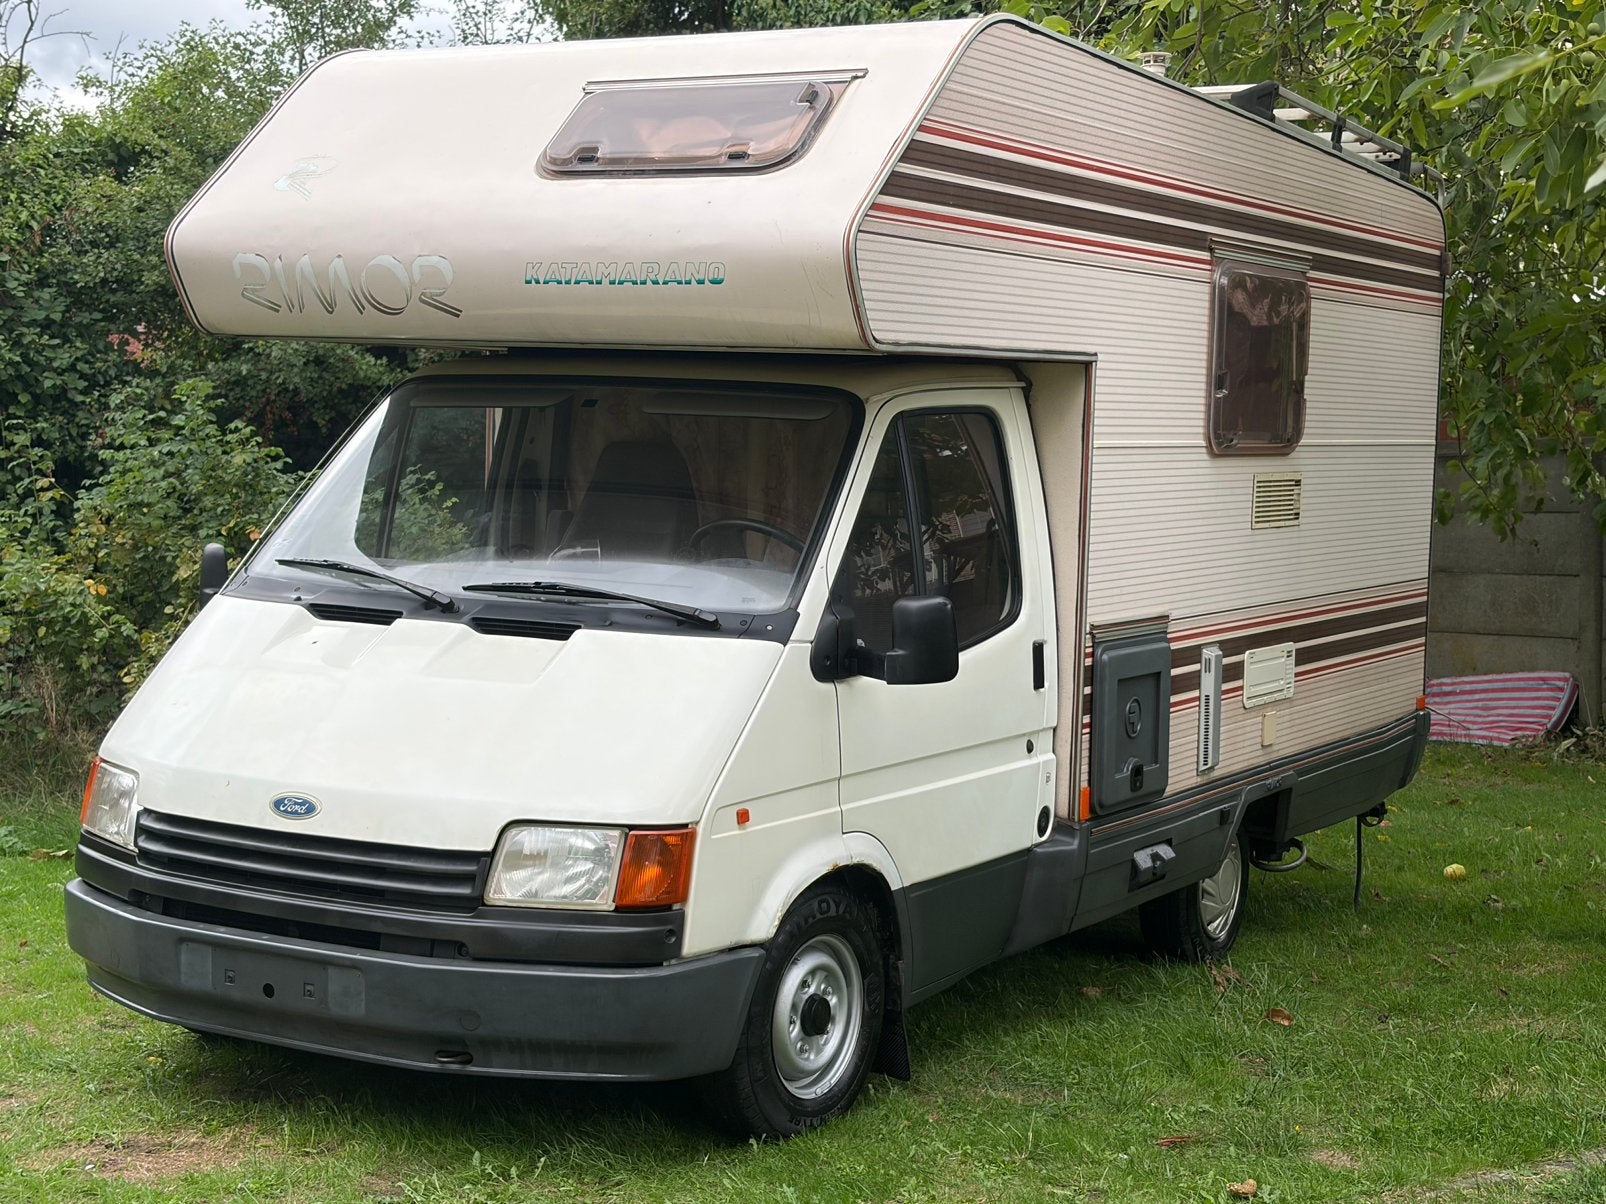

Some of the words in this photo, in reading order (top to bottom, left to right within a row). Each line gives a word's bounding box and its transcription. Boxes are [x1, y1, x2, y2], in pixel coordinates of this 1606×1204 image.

[232, 252, 463, 318] RIMOR
[524, 261, 726, 285] KATAMARANO
[280, 797, 310, 813] Ford
